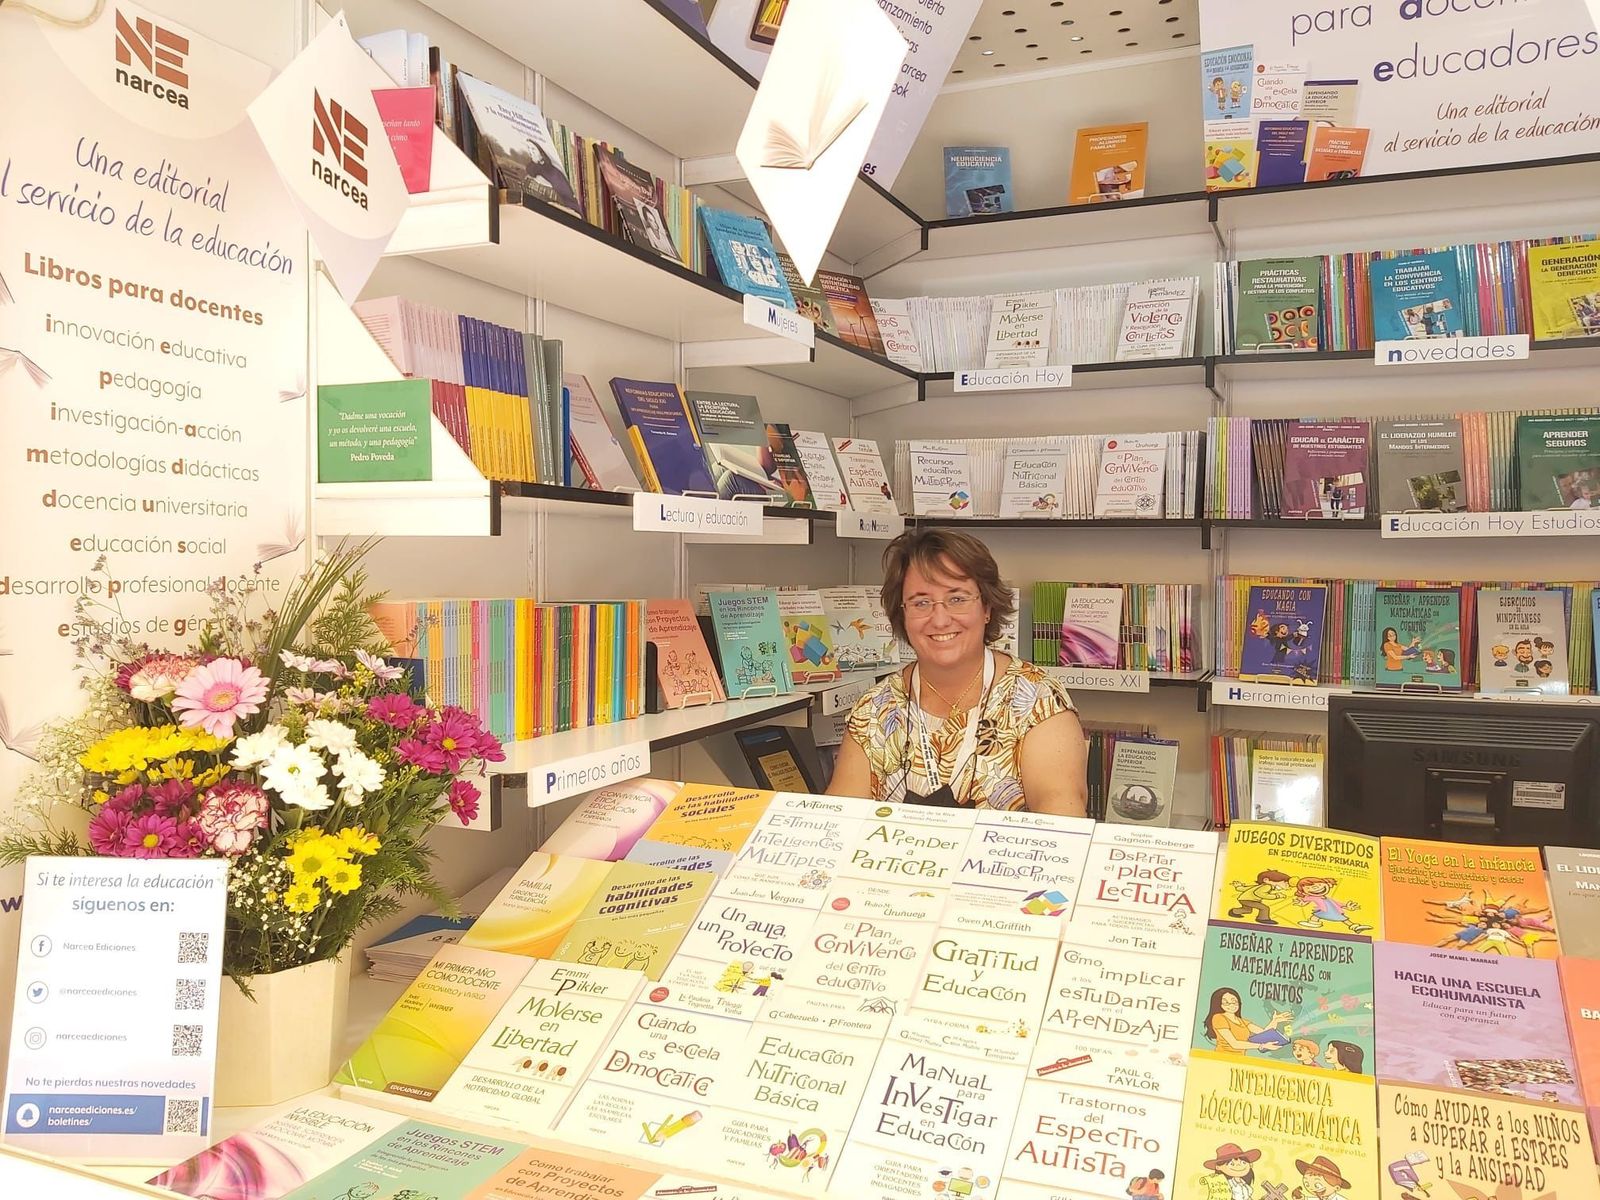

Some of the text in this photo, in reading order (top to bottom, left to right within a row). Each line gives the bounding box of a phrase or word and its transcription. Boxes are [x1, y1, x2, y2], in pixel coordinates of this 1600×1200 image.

[1292, 3, 1372, 46] para
[1373, 28, 1598, 83] educadores
[115, 66, 190, 110] narcea
[1437, 87, 1550, 121] Una editorial
[1383, 112, 1600, 154] al servicio de la educación
[75, 136, 230, 213] Una editorial
[312, 157, 369, 212] narcea
[16, 182, 293, 275] servicio de la educación
[1395, 265, 1430, 274] TRABAJAR
[1542, 254, 1600, 265] GENERACIÓN
[1550, 263, 1597, 271] GENERACIÓN
[1395, 270, 1441, 280] CONVIVENCIA
[1411, 276, 1443, 284] CENTROS
[1557, 269, 1596, 277] DERECHOS
[24, 252, 264, 325] Libros para docentes
[1393, 283, 1435, 292] EDUCATIVOS
[768, 308, 799, 334] Mujeres
[45, 313, 247, 369] innovación educativa
[1388, 337, 1515, 362] novedades
[99, 368, 201, 402] pedagogía
[961, 370, 1063, 386] Educación Hoy
[50, 403, 242, 443] investigación-acción
[26, 446, 259, 481] metodologías didácticas
[351, 452, 394, 461] Pedro Poveda
[43, 489, 248, 517] docencia universitaria
[660, 504, 748, 527] Lectura y educación
[1391, 513, 1600, 533] Educación Hoy Estudios
[70, 534, 226, 554] educación social
[0, 576, 101, 595] desarrollo
[1262, 589, 1295, 601] EDUCANDO
[1276, 601, 1297, 611] MAGIA
[1383, 594, 1450, 606] ENSEÑAR APRENDER
[1500, 597, 1536, 607] EJERCICIOS
[1390, 607, 1432, 619] MATEMÁTICAS
[1496, 613, 1541, 623] MINDFULNESS
[146, 617, 169, 632] de
[1120, 675, 1141, 687] XXI
[1228, 687, 1328, 706] Herramienta
[546, 755, 640, 794] Primeros años
[685, 790, 736, 803] Desarrollo
[704, 793, 760, 806] habilidades
[680, 804, 736, 818] sociales
[983, 831, 1057, 848] Recursos
[1114, 835, 1195, 849] Gagnon-Roberge
[1234, 830, 1374, 859] JUEGOS DIVERTIDOS
[1280, 849, 1369, 869] EDUCACIÓN PRIMARIA
[1405, 848, 1536, 872] Yoga infancia
[37, 872, 214, 889] Si te interesa la educación
[605, 880, 693, 903] habilidades
[770, 891, 804, 904] Vergara
[72, 896, 174, 914] síguenos en:
[599, 895, 679, 915] cognitivas
[63, 942, 136, 952] Narcea Ediciones
[1109, 935, 1157, 950] Jon Tait
[1219, 933, 1354, 964] ENSEÑAR APRENDER
[1231, 955, 1315, 982] MATEMÁTICAS
[1448, 954, 1469, 963] MANEL
[1470, 956, 1499, 965] MARRASÉ
[426, 970, 502, 990] COMO DOCENTE
[444, 963, 496, 979] PRIMER AÑO
[550, 969, 590, 982] Emmi
[1250, 981, 1303, 1004] CUENTOS
[1394, 970, 1541, 999] HACIA UNA ESCUELA
[1411, 985, 1525, 1010] ECOHUMANISTA
[638, 1013, 697, 1034] Cuándo
[56, 1033, 127, 1041] narceaediciones
[492, 1026, 578, 1056] Libertad
[1114, 1067, 1140, 1077] PAUL
[25, 1077, 196, 1090] No te pierdas nuestras novedades
[1107, 1074, 1160, 1091] TAYLOR
[1229, 1068, 1334, 1107] INTELIGENCIA
[754, 1086, 819, 1112] Básica
[1059, 1092, 1147, 1117] Trastornos
[49, 1106, 138, 1115] narceaediciones.es/
[1200, 1092, 1362, 1146] LÓGICO-MATEMÁTICA
[1394, 1094, 1581, 1145] Cómo AYUDAR NIÑOS
[48, 1117, 92, 1126] boletines/
[1423, 1121, 1569, 1170] SUPERAR ESTRÉS
[1468, 1154, 1546, 1194] ANSIEDAD
